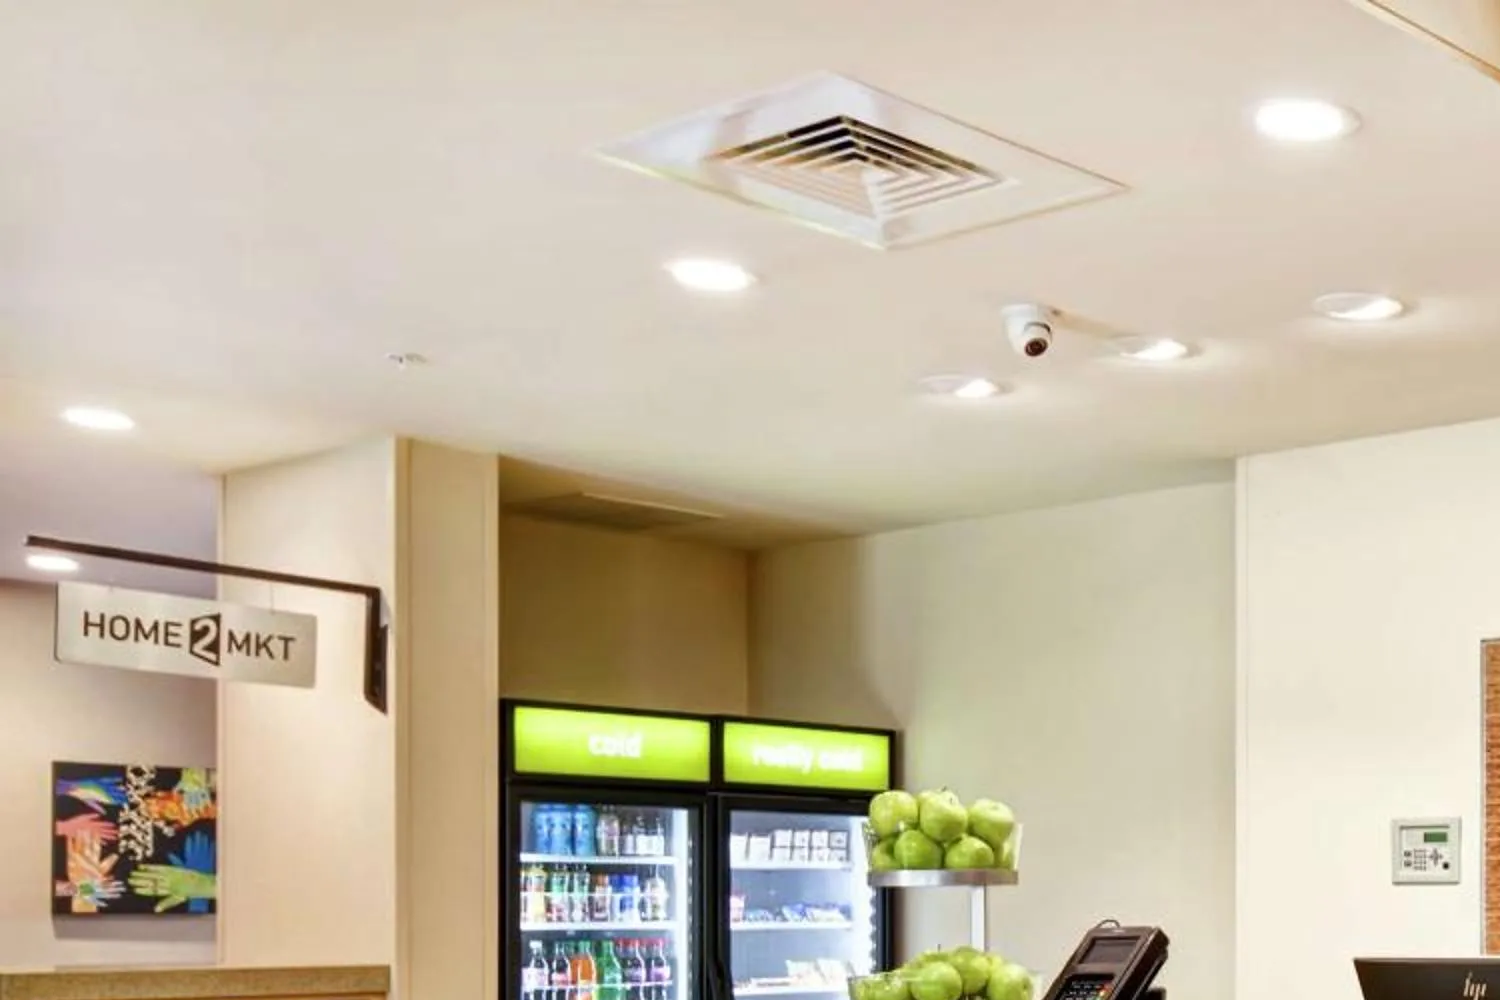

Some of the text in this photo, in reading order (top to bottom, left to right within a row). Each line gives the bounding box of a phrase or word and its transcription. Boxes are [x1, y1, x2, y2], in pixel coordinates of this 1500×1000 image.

[82, 610, 296, 664] HOME 2 MKT
